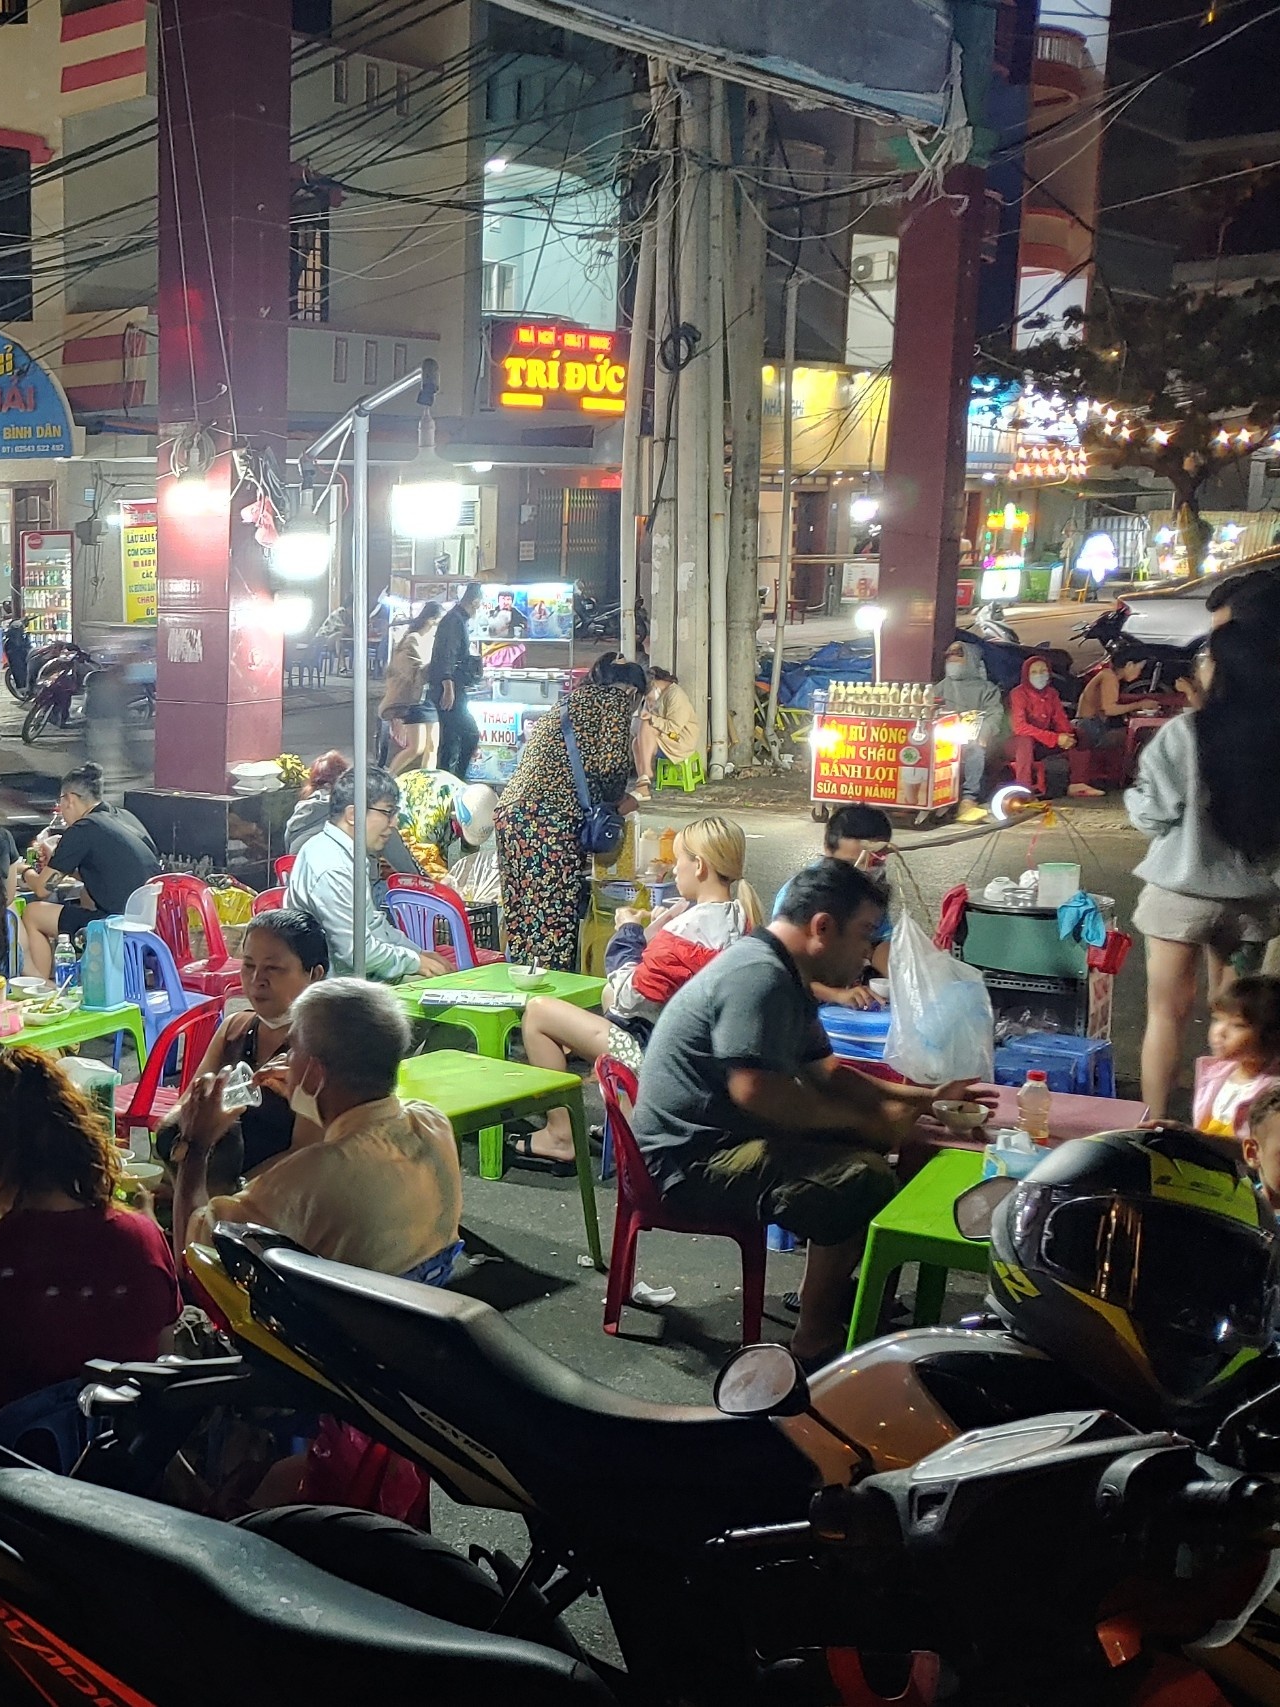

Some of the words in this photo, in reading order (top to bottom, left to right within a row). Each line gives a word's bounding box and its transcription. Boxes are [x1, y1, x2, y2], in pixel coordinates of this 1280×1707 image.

[504, 350, 561, 389] TRÍ
[564, 354, 625, 393] ĐỨC
[3, 424, 33, 440] BÌNH
[36, 423, 62, 438] DÂN
[870, 722, 907, 744] NÓNG
[859, 744, 896, 762] CHÂU
[820, 760, 862, 779] BÁNH
[865, 766, 897, 785] LỌT
[817, 779, 837, 794] SỮA
[840, 781, 862, 799] ĐẬU
